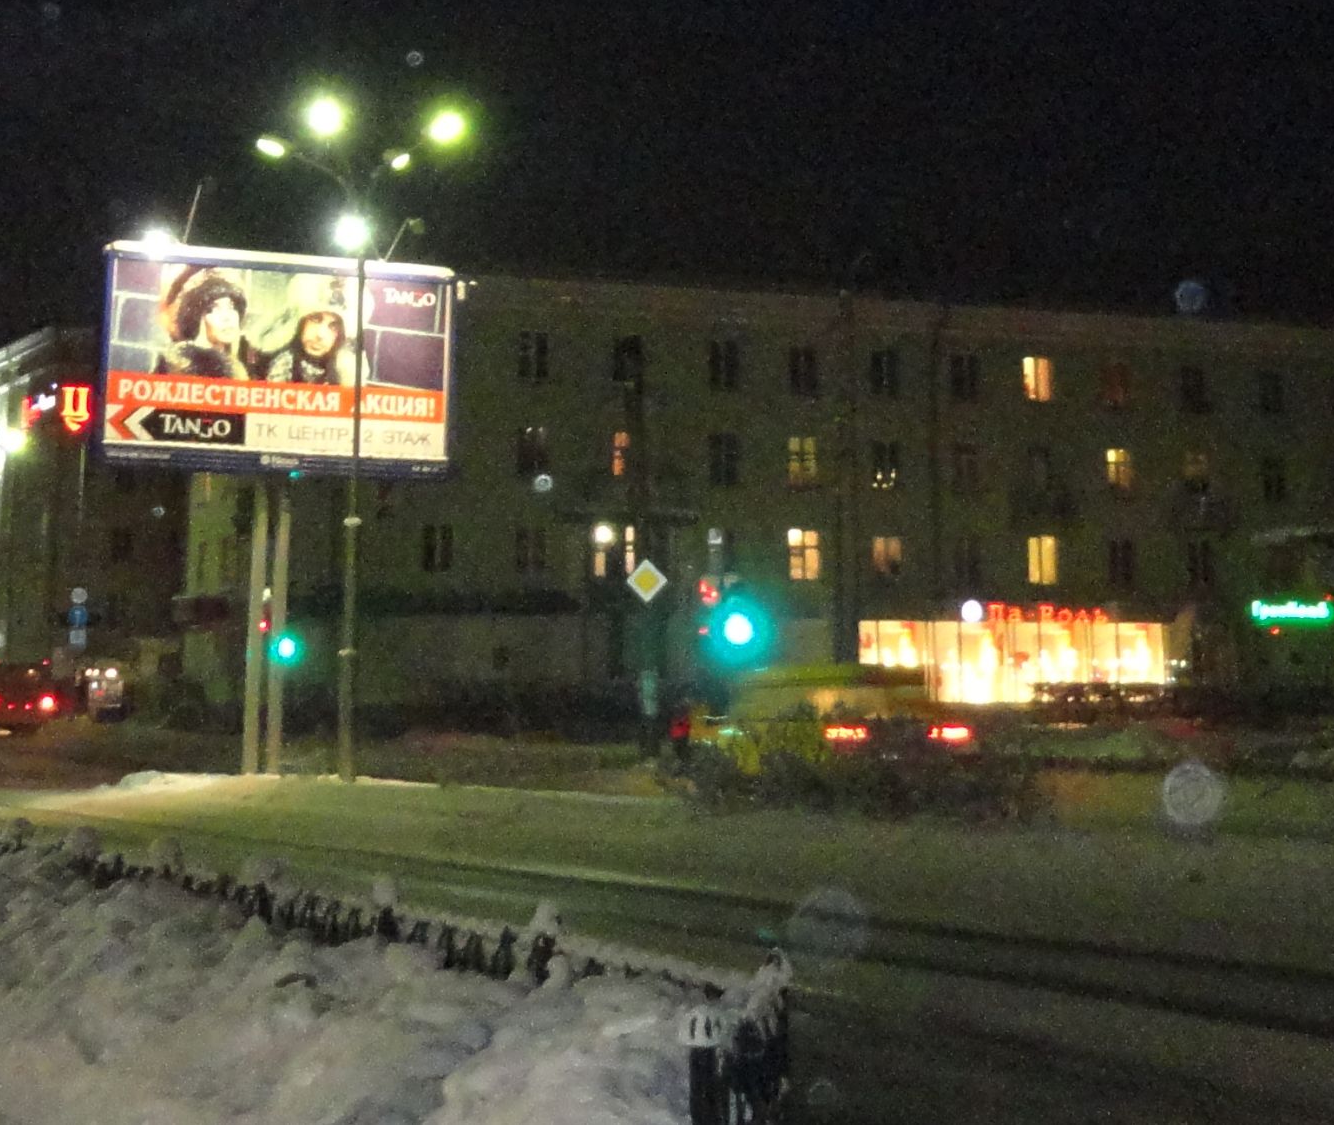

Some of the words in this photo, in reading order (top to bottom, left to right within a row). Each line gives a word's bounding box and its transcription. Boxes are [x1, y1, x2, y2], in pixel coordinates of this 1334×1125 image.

[118, 379, 340, 412] РОЖДЕСТВЕНСКАЯ
[256, 423, 278, 438] ТК
[364, 432, 372, 443] 2
[383, 431, 430, 445] ЭТАЖ
